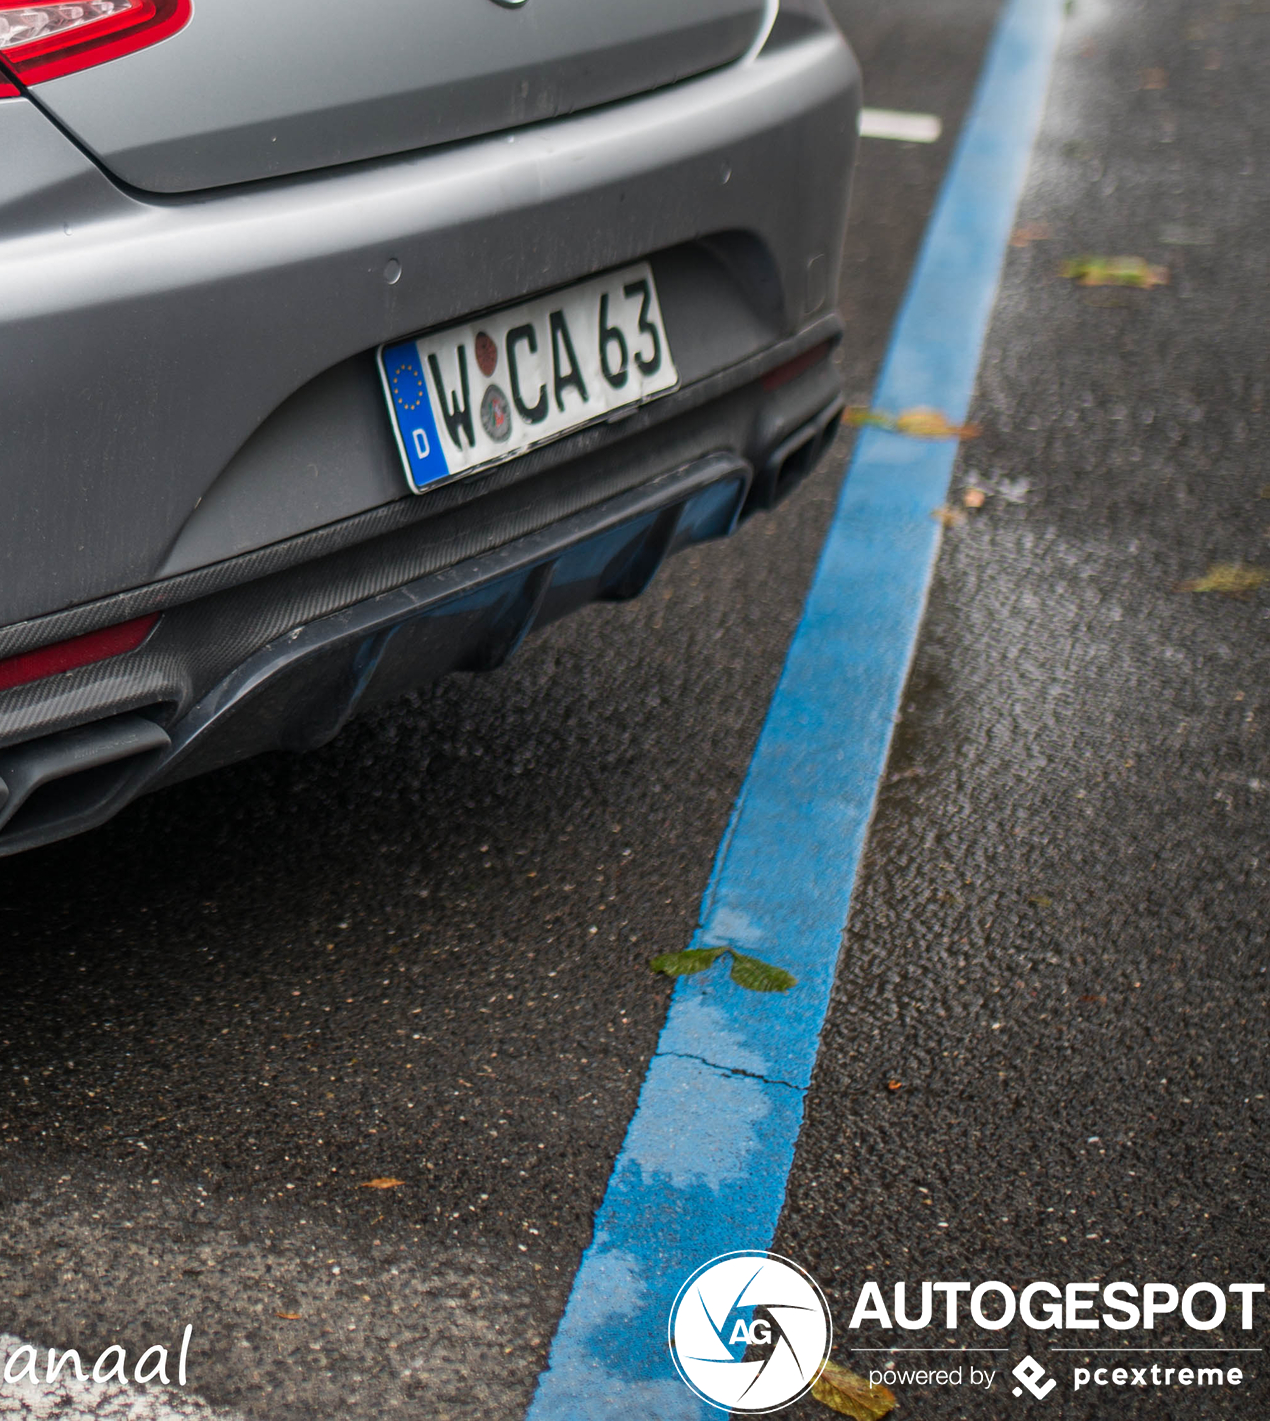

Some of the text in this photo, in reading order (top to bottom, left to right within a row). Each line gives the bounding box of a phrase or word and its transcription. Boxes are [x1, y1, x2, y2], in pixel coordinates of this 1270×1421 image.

[427, 278, 662, 452] W CA 63
[412, 428, 431, 460] D
